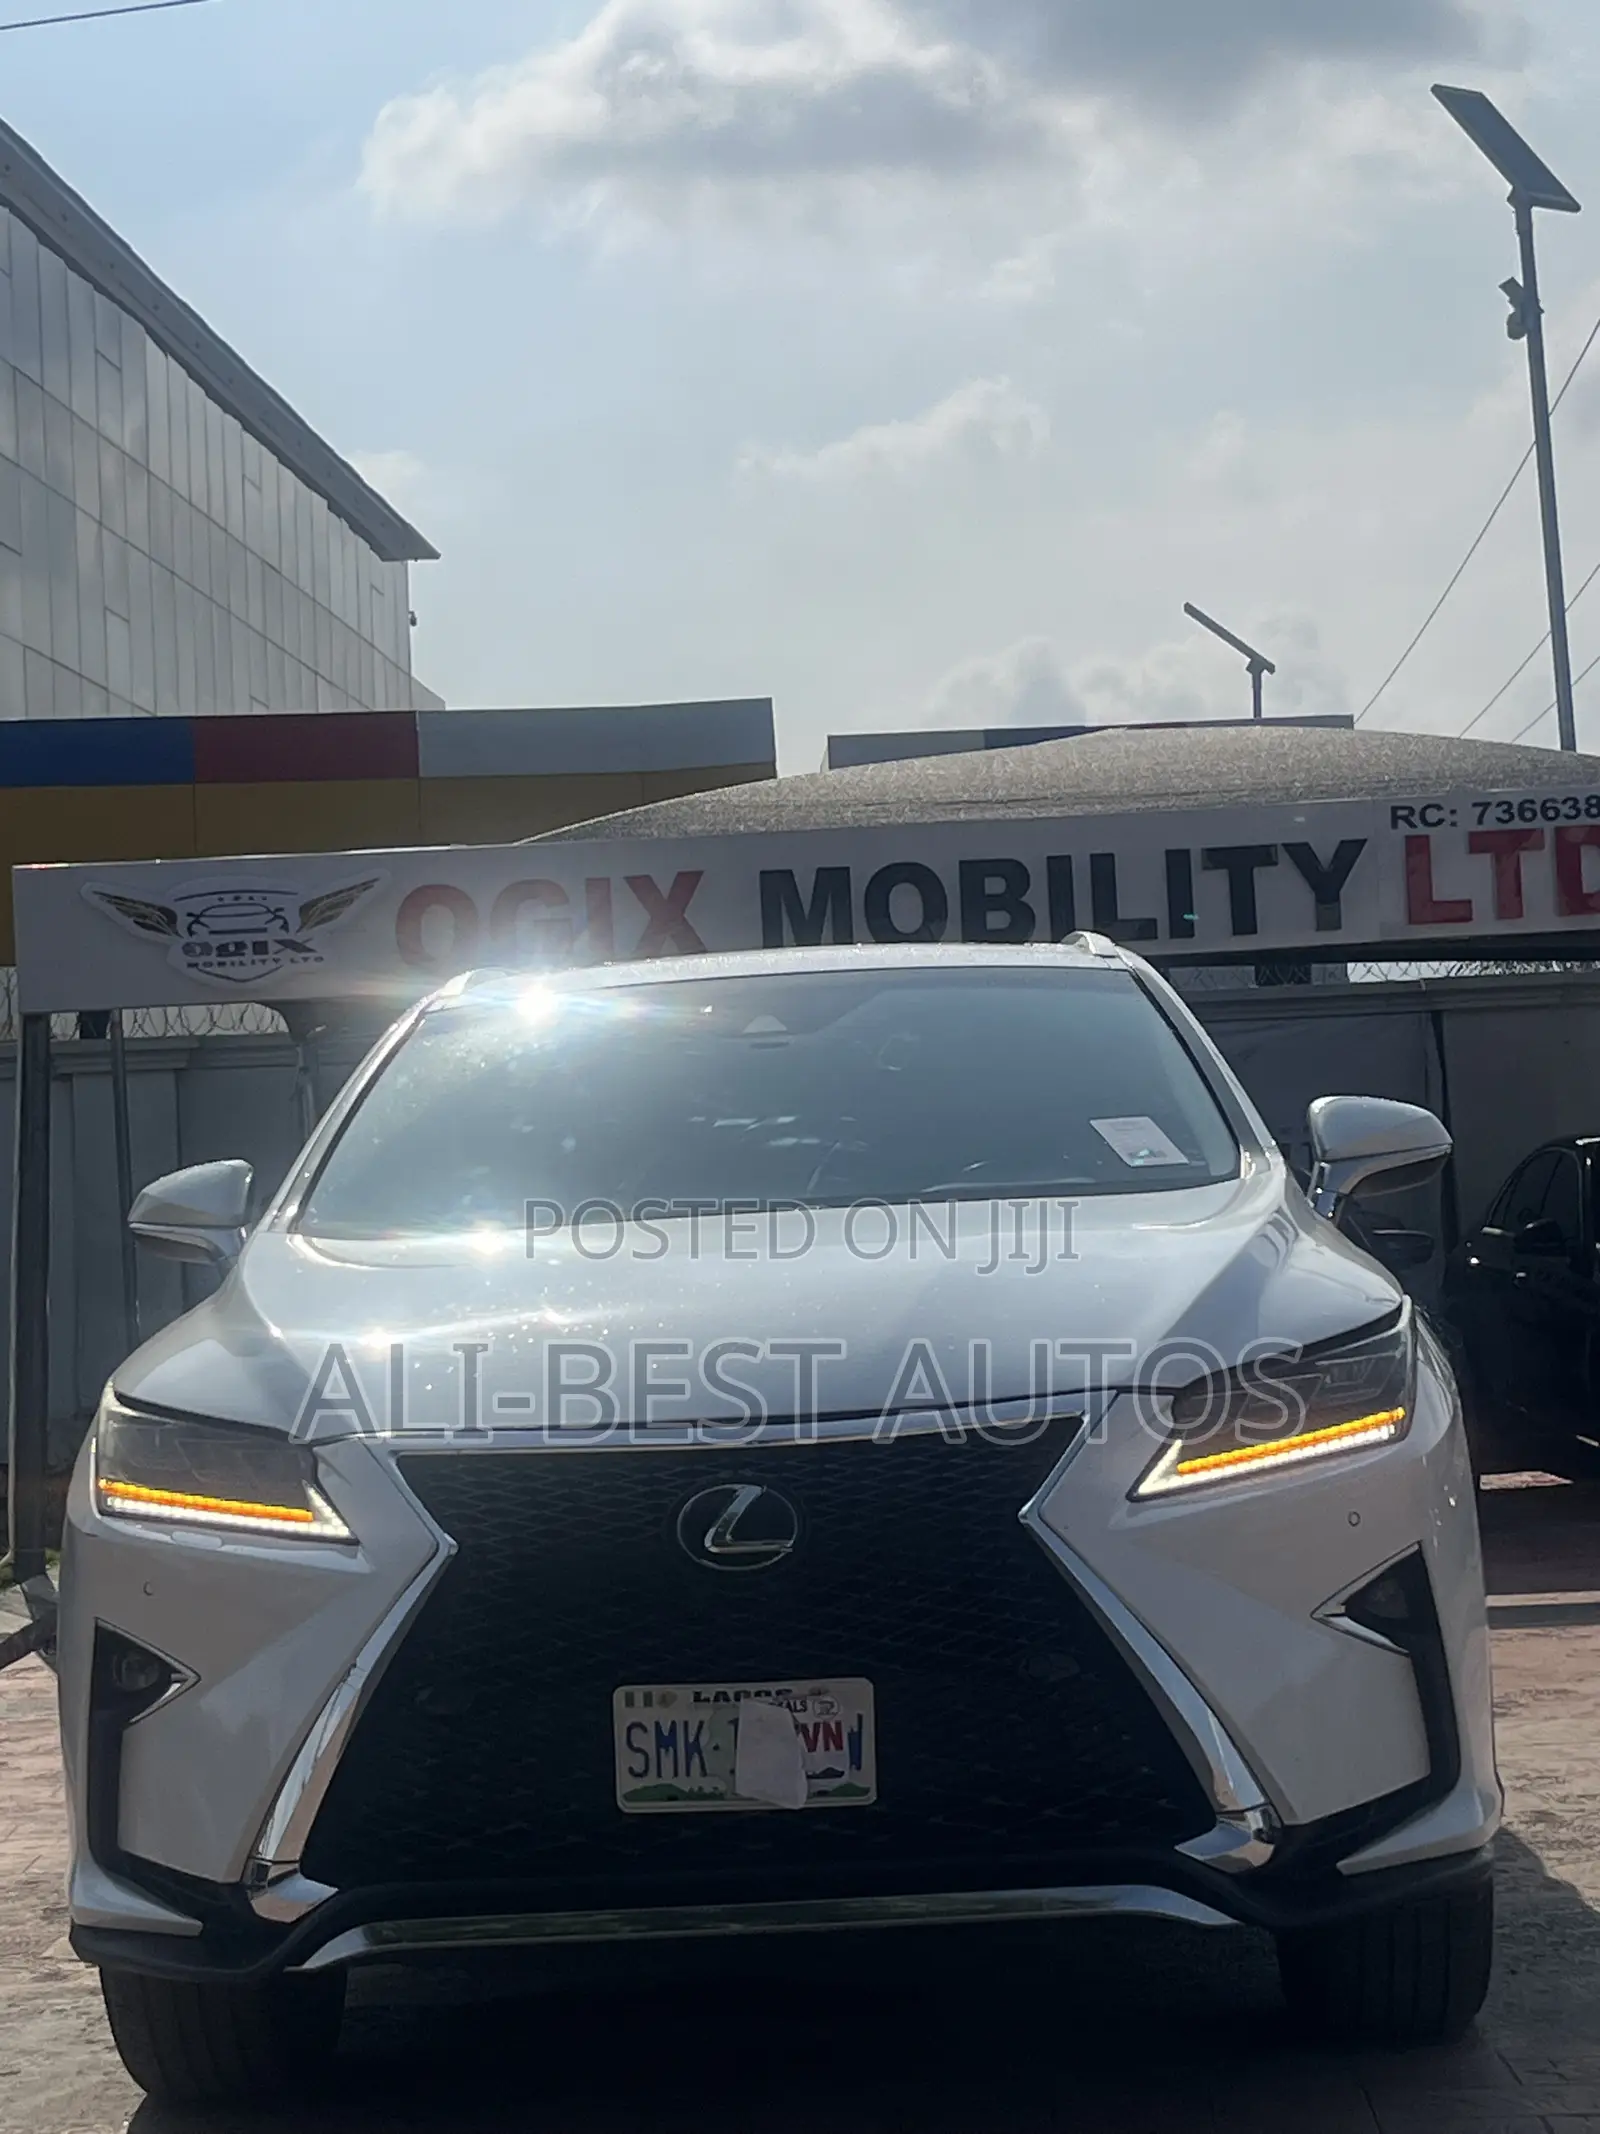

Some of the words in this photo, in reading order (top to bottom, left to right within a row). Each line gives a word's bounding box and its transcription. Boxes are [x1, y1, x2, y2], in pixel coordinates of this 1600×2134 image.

[1390, 803, 1457, 829] RC:
[1472, 795, 1600, 826] 736638
[395, 869, 709, 965] OGIX
[759, 838, 1368, 945] MOBILITY
[1405, 825, 1600, 924] LTD
